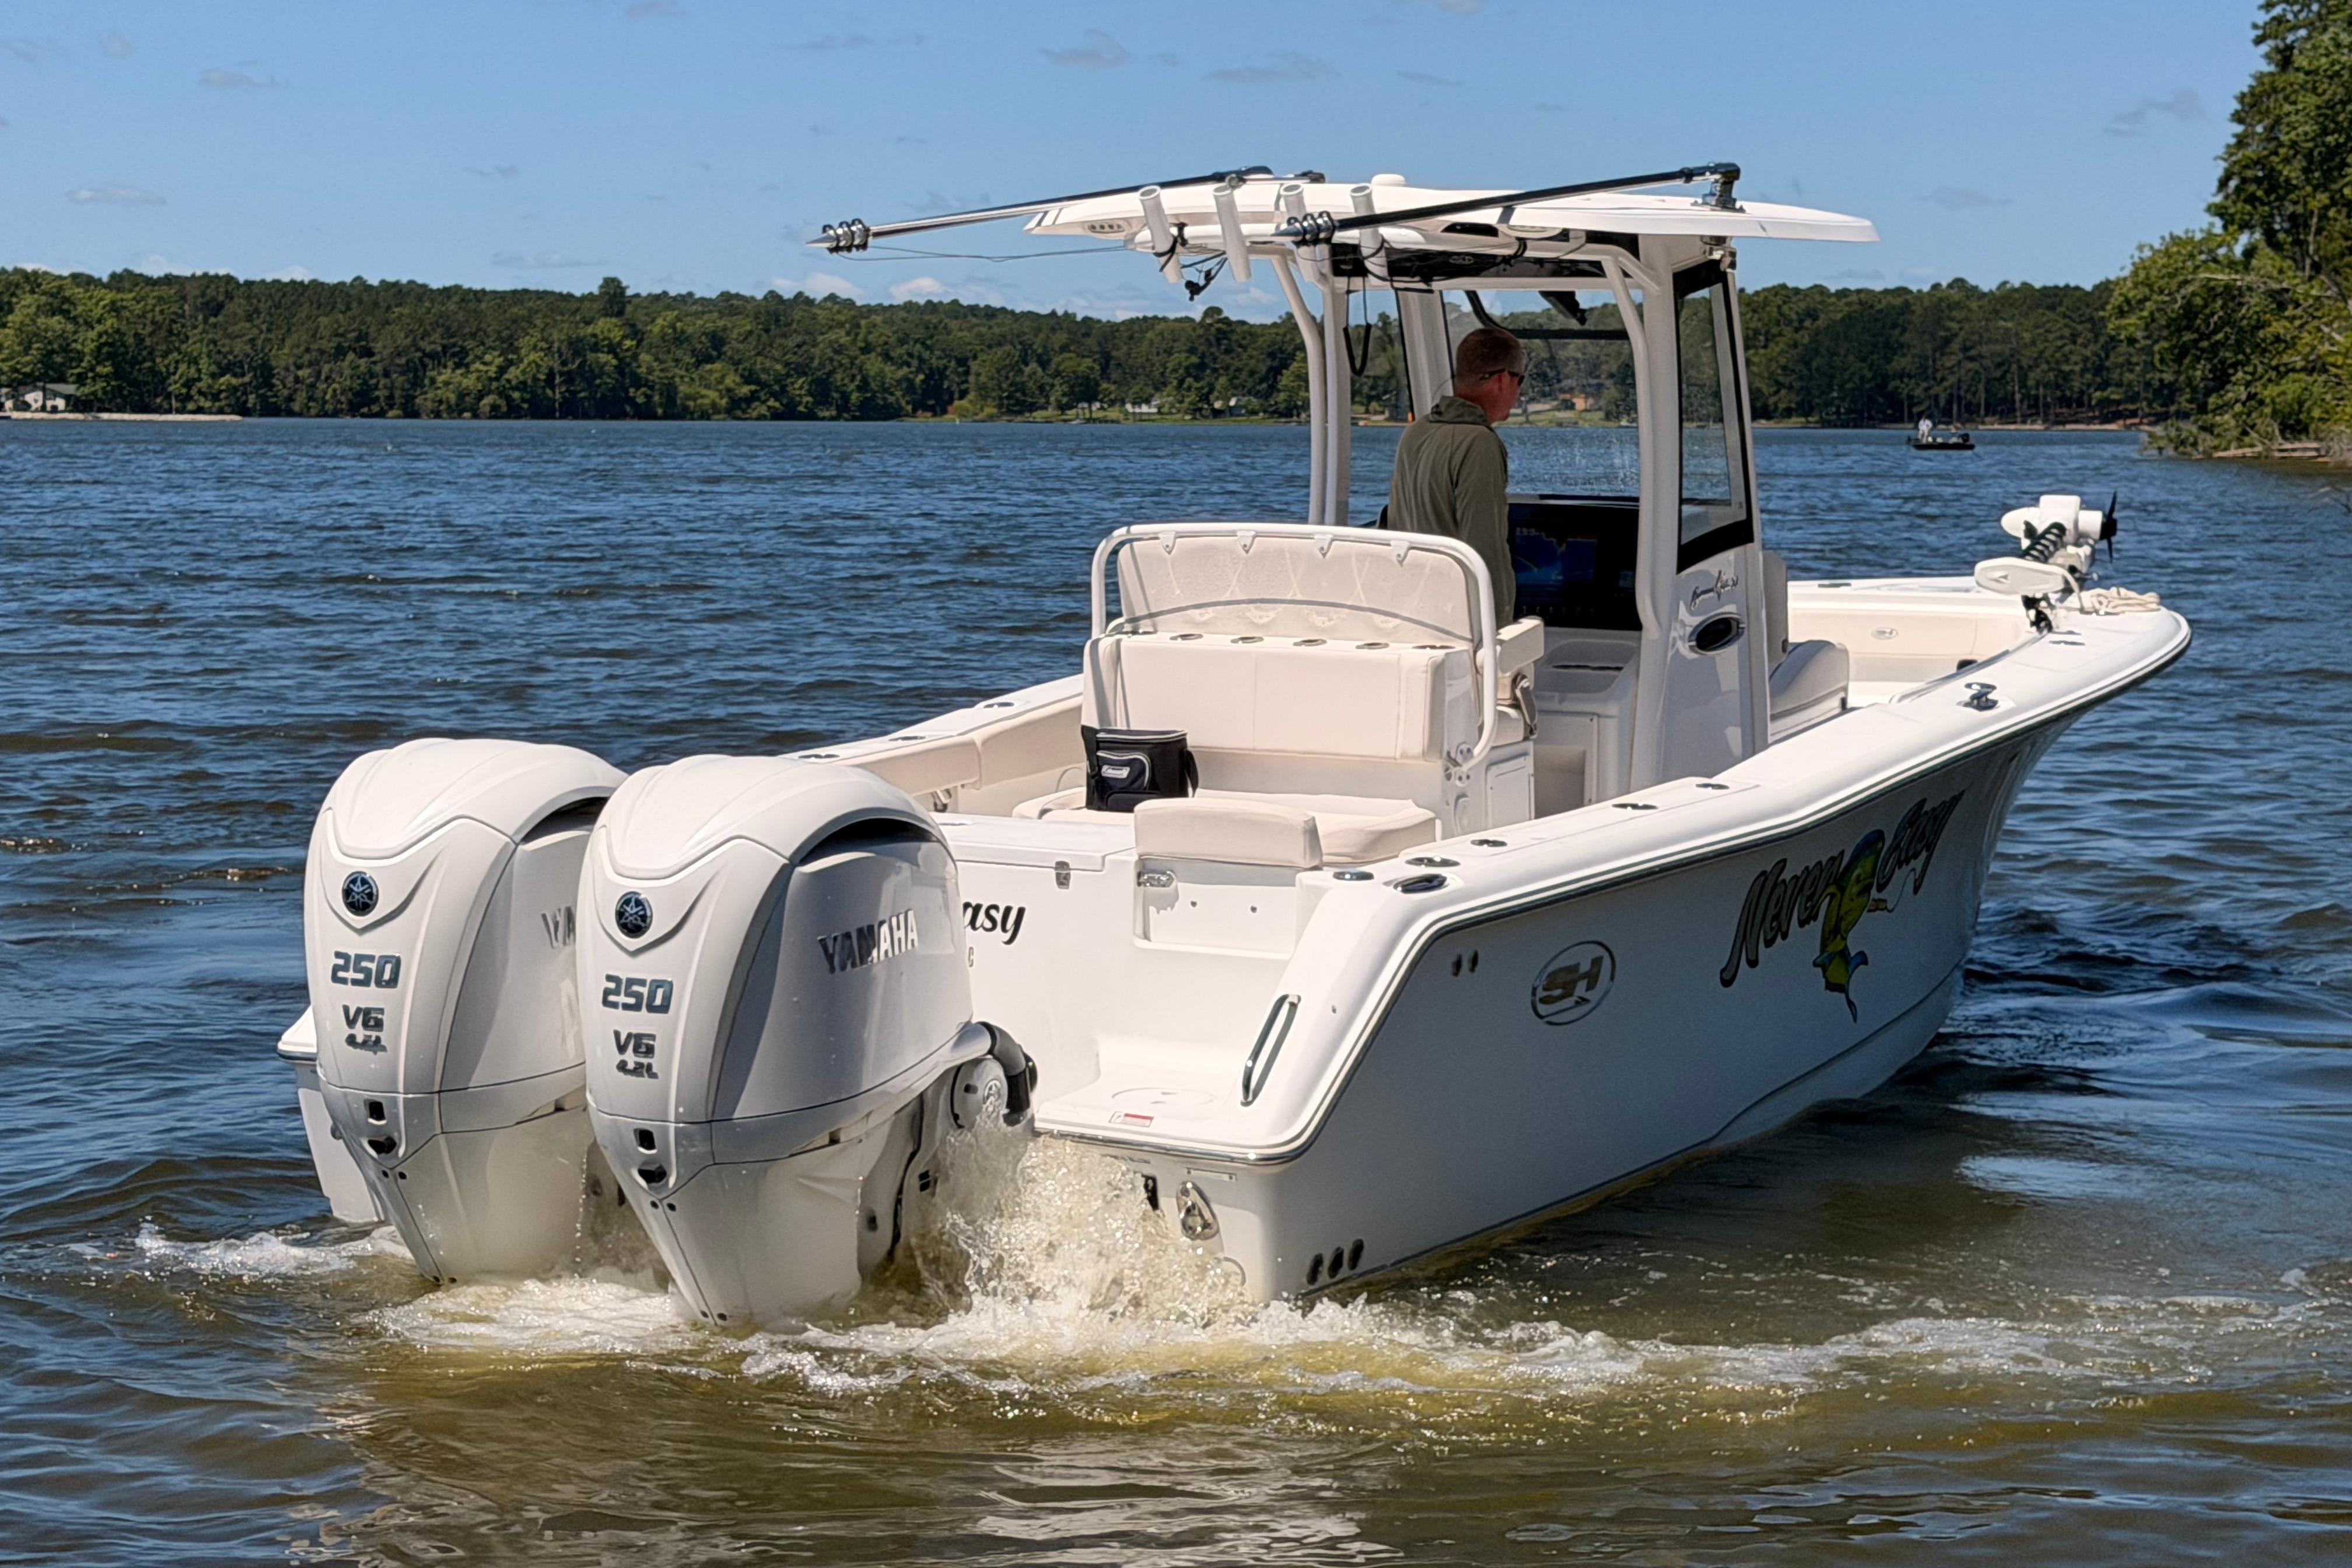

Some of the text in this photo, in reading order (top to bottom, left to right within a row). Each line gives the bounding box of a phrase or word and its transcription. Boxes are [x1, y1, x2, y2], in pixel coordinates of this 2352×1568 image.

[817, 908, 919, 975] YAMAHA
[963, 901, 1026, 946] asy
[331, 951, 402, 989] 250
[601, 974, 674, 1014] 250
[342, 1004, 385, 1032] V6
[613, 1029, 657, 1059] V6
